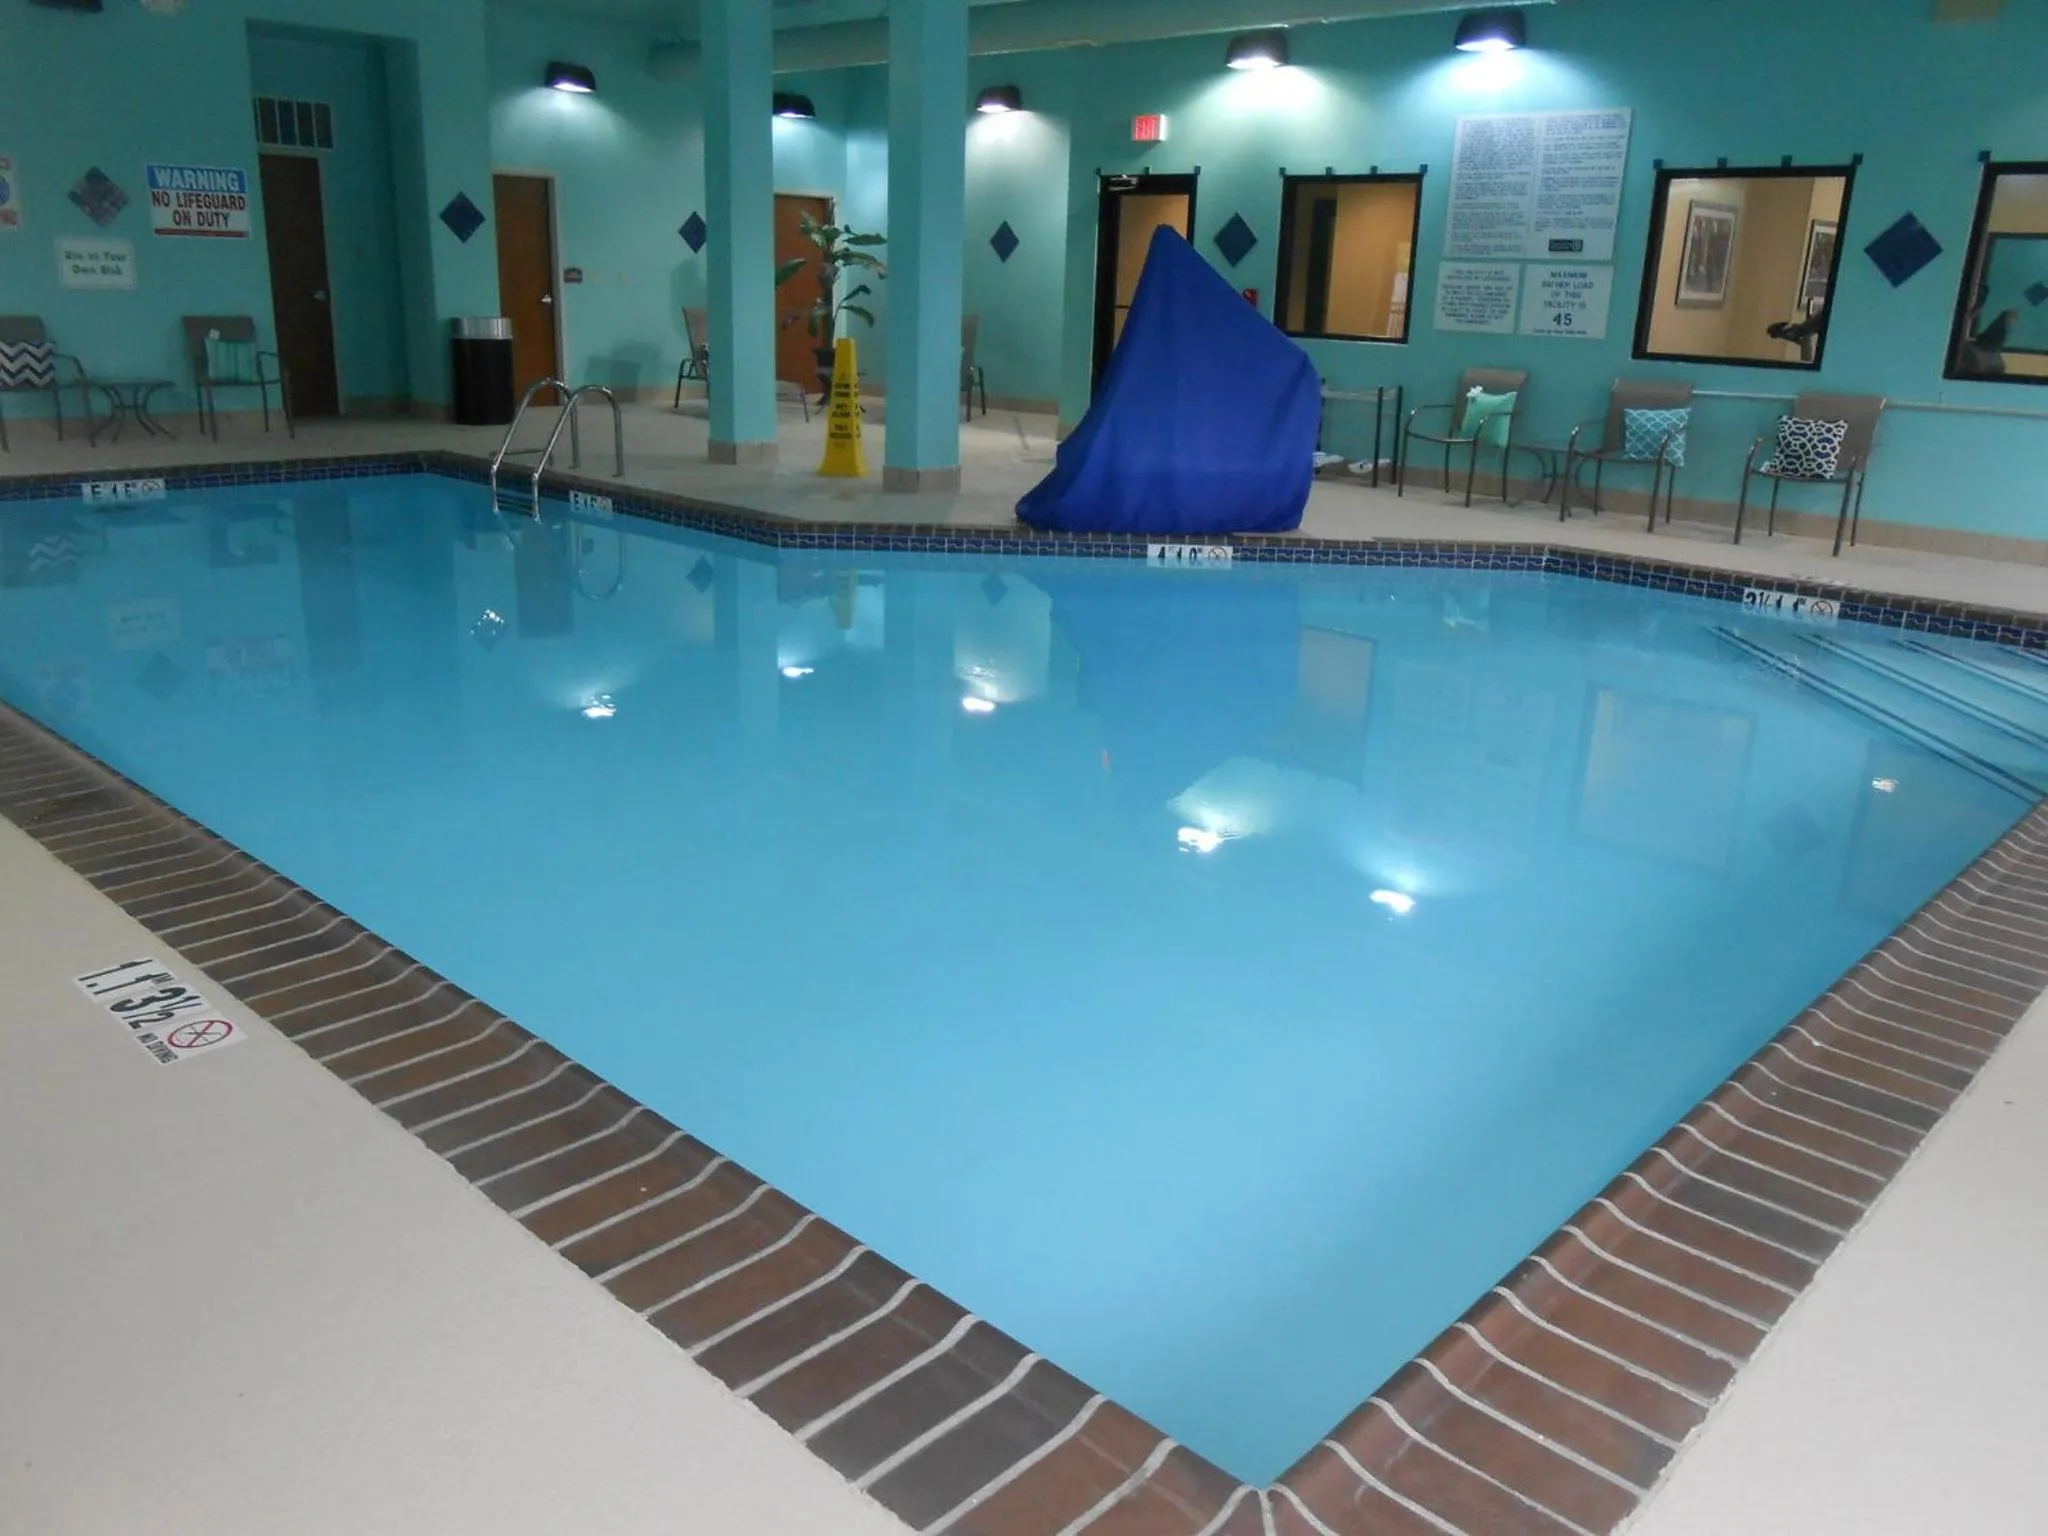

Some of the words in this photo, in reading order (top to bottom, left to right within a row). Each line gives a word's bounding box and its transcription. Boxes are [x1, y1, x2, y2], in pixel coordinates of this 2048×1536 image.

[153, 167, 239, 191] WARNING
[151, 191, 170, 207] NO
[176, 192, 245, 210] LIFEGUARD
[173, 210, 192, 226] ON
[197, 211, 230, 227] DUTY
[1552, 312, 1573, 327] 45
